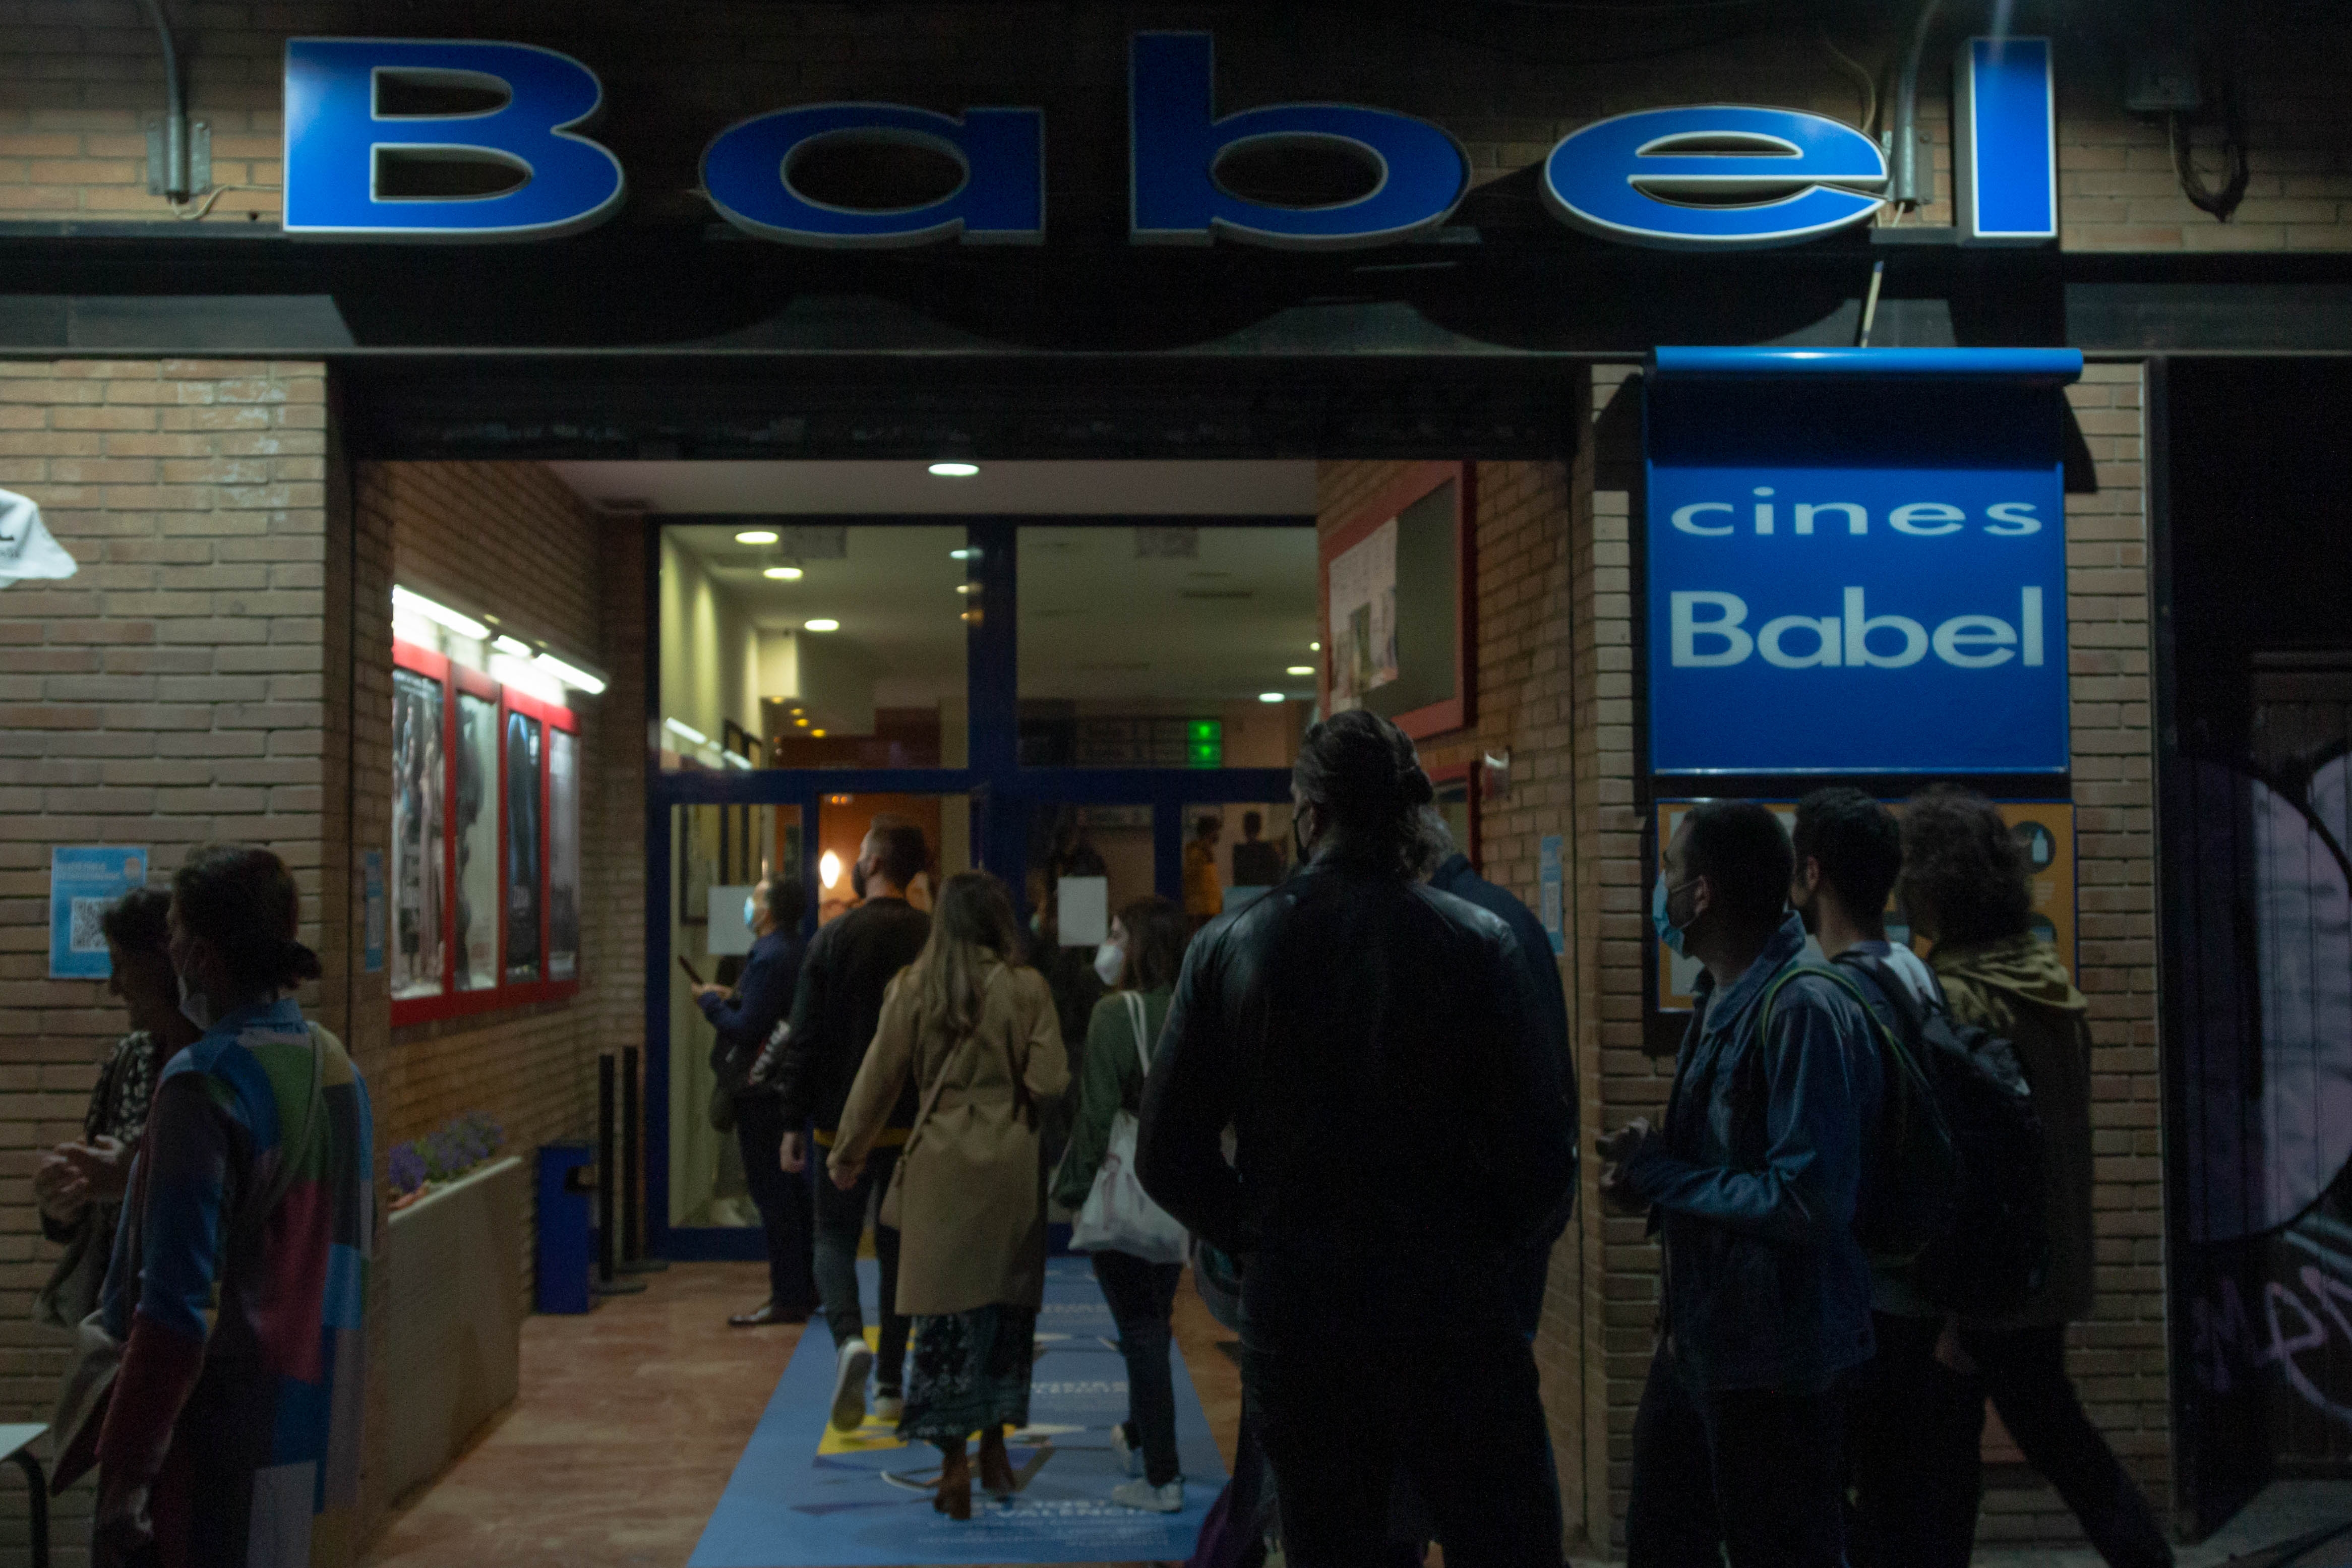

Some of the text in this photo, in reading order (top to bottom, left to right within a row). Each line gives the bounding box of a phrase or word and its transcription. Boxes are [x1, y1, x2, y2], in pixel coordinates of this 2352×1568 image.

[281, 29, 2059, 244] Babel
[1671, 486, 2042, 536] cines
[1670, 585, 2044, 668] Babel
